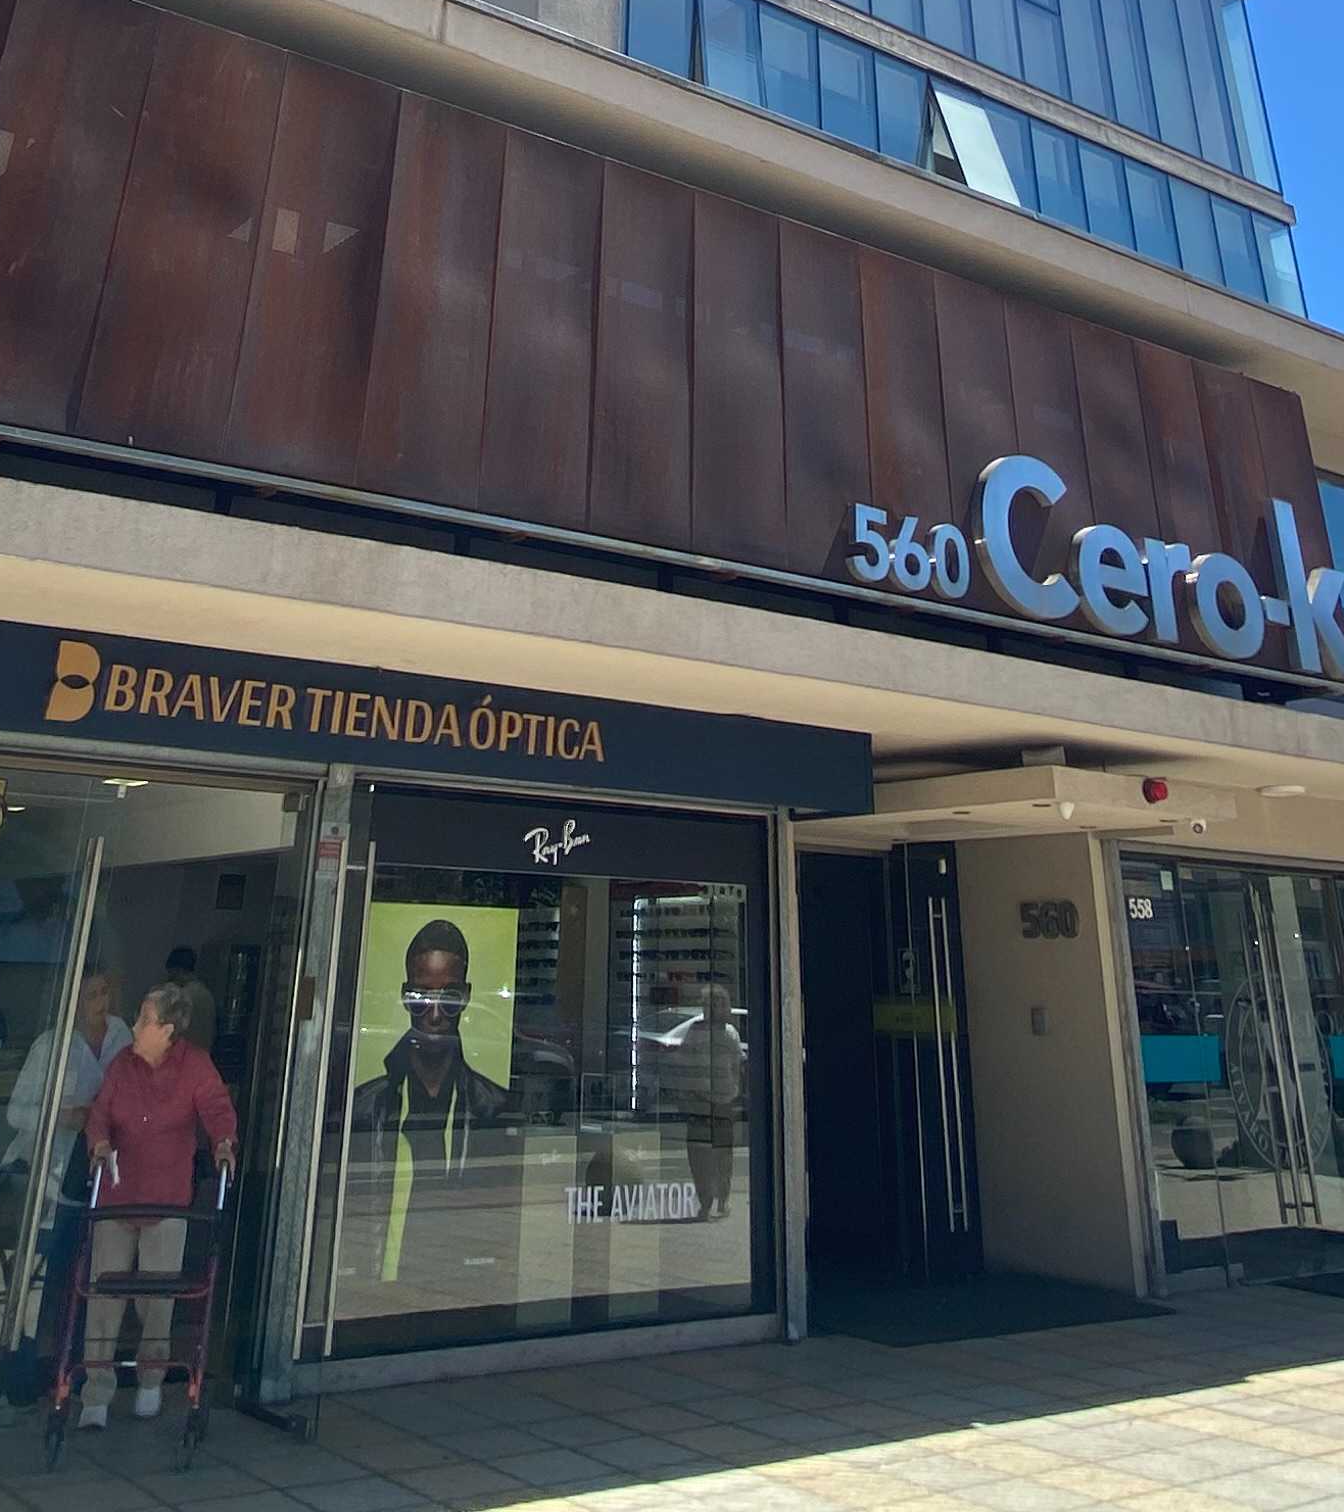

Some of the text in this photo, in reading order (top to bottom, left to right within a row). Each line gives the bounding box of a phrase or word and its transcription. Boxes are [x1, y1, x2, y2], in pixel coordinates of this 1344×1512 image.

[846, 502, 971, 599] 560
[104, 663, 296, 731] BRAVER
[306, 686, 462, 748] TIENDA
[468, 694, 605, 763] ÓPTICA
[523, 819, 591, 866] Ray-Ban
[1019, 899, 1080, 939] 560
[1128, 898, 1154, 920] 558
[564, 1182, 700, 1225] THE AVIATOR
